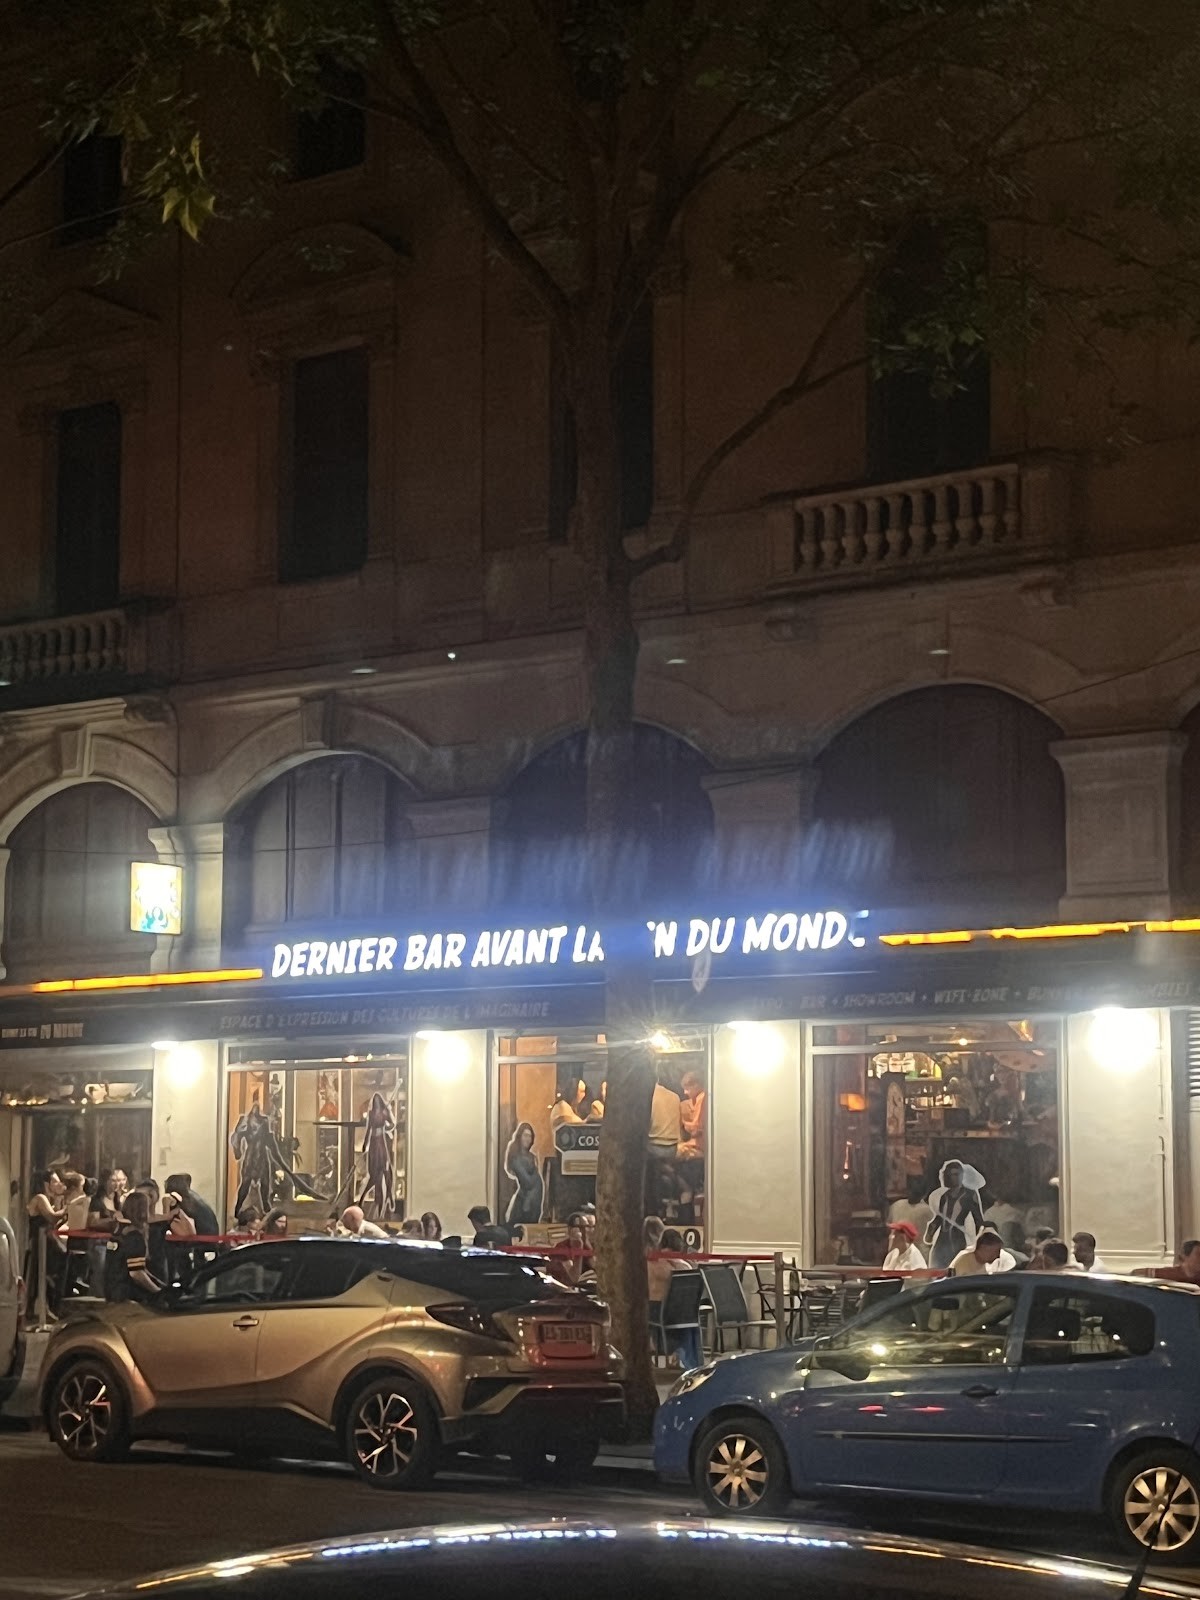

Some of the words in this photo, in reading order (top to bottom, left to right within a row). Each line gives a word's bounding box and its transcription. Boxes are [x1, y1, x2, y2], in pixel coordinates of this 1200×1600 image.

[271, 936, 398, 979] DERNIER
[403, 933, 467, 971] BAR
[471, 926, 568, 967] AVANT
[572, 925, 604, 963] LA
[686, 916, 736, 957] DU
